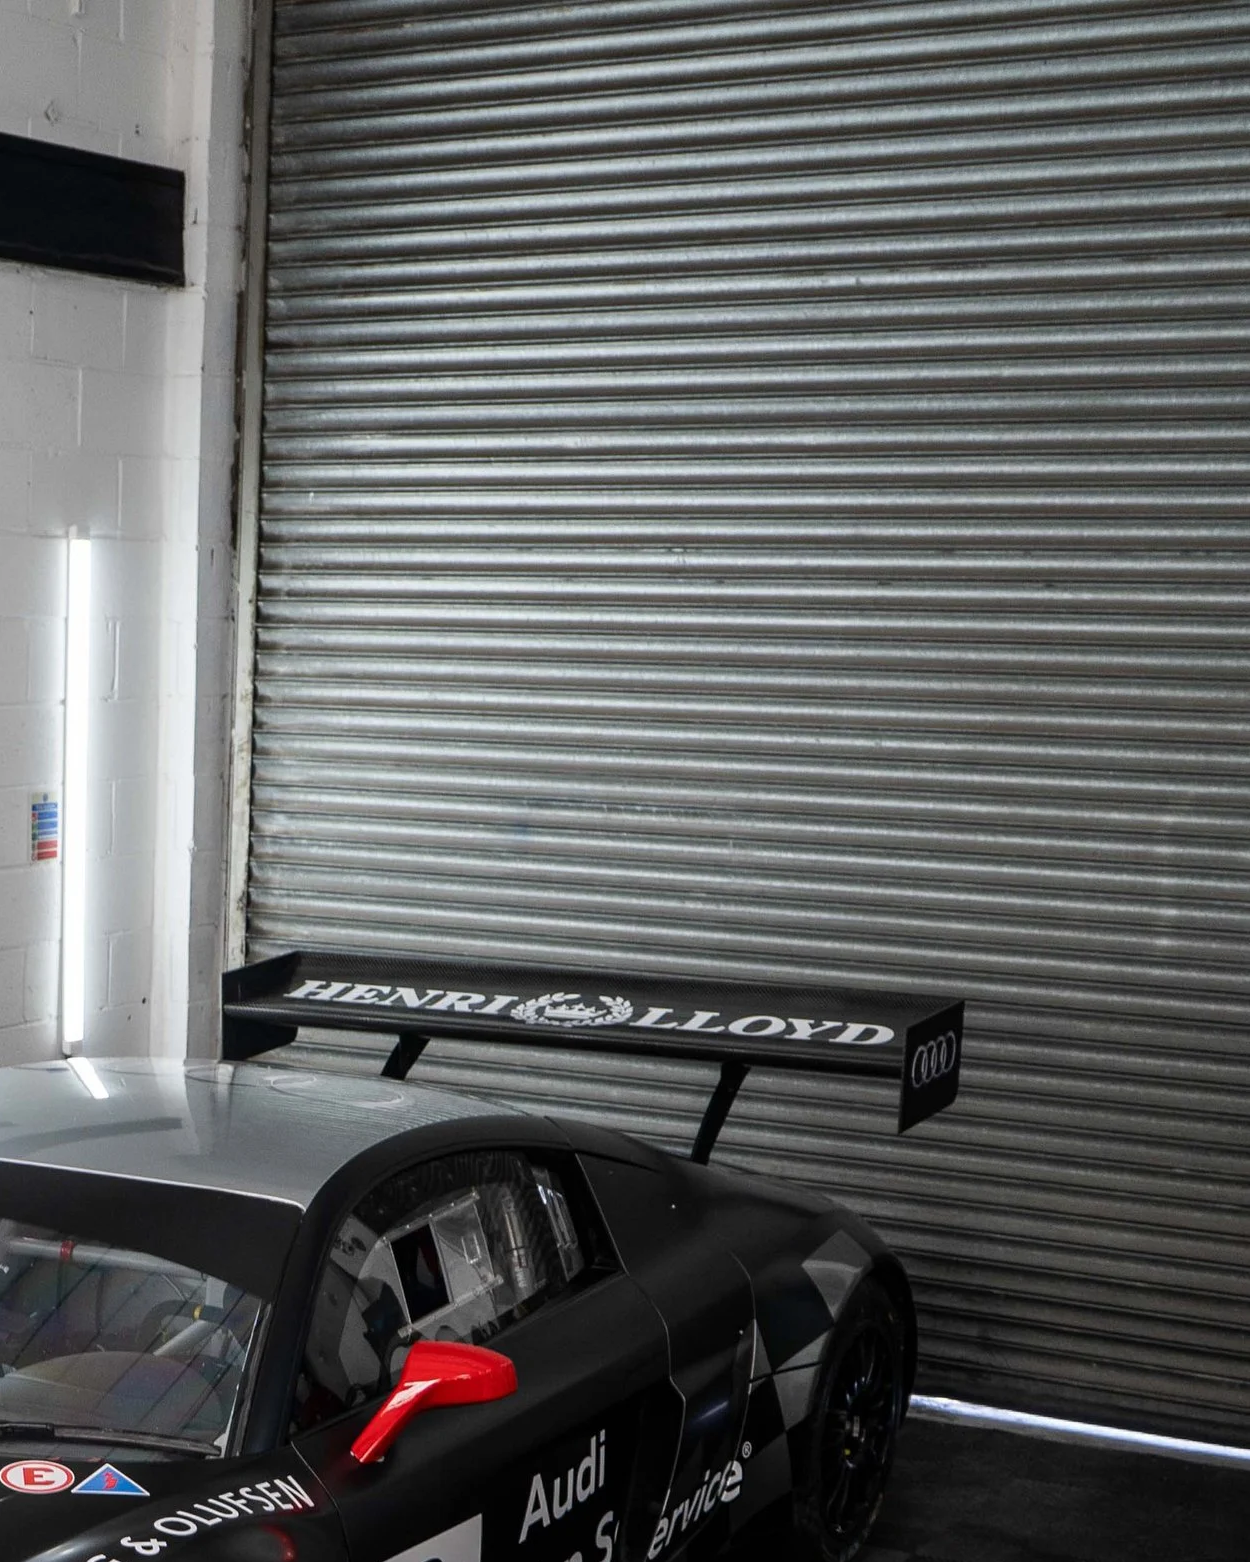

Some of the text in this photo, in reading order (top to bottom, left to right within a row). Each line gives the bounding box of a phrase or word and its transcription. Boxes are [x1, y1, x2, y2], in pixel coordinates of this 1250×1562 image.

[284, 980, 896, 1047] HENRI LLOYD
[22, 1467, 56, 1486] E
[518, 1430, 606, 1545] Audi
[120, 1536, 168, 1556] &
[153, 1475, 315, 1538] OLUFSEN
